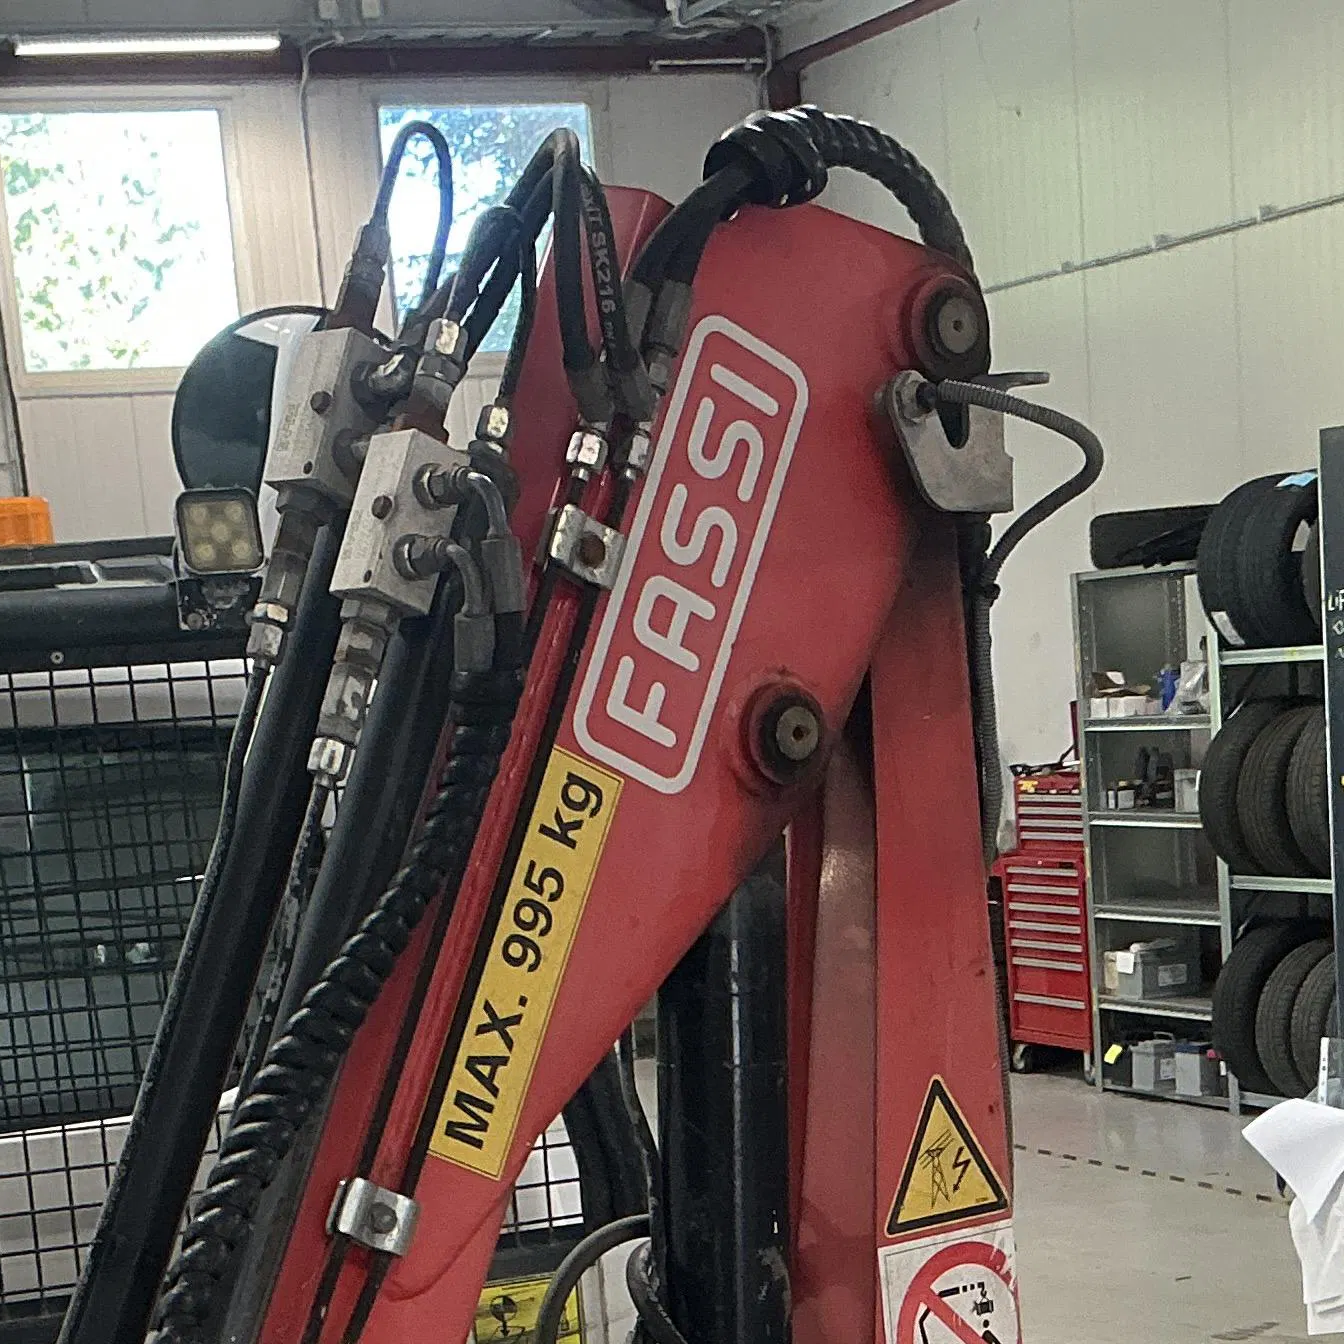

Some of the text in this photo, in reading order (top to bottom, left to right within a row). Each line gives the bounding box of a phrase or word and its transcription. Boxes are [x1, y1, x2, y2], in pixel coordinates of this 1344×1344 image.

[606, 362, 779, 748] FASSI
[444, 771, 604, 1151] MAX. 995 kg
